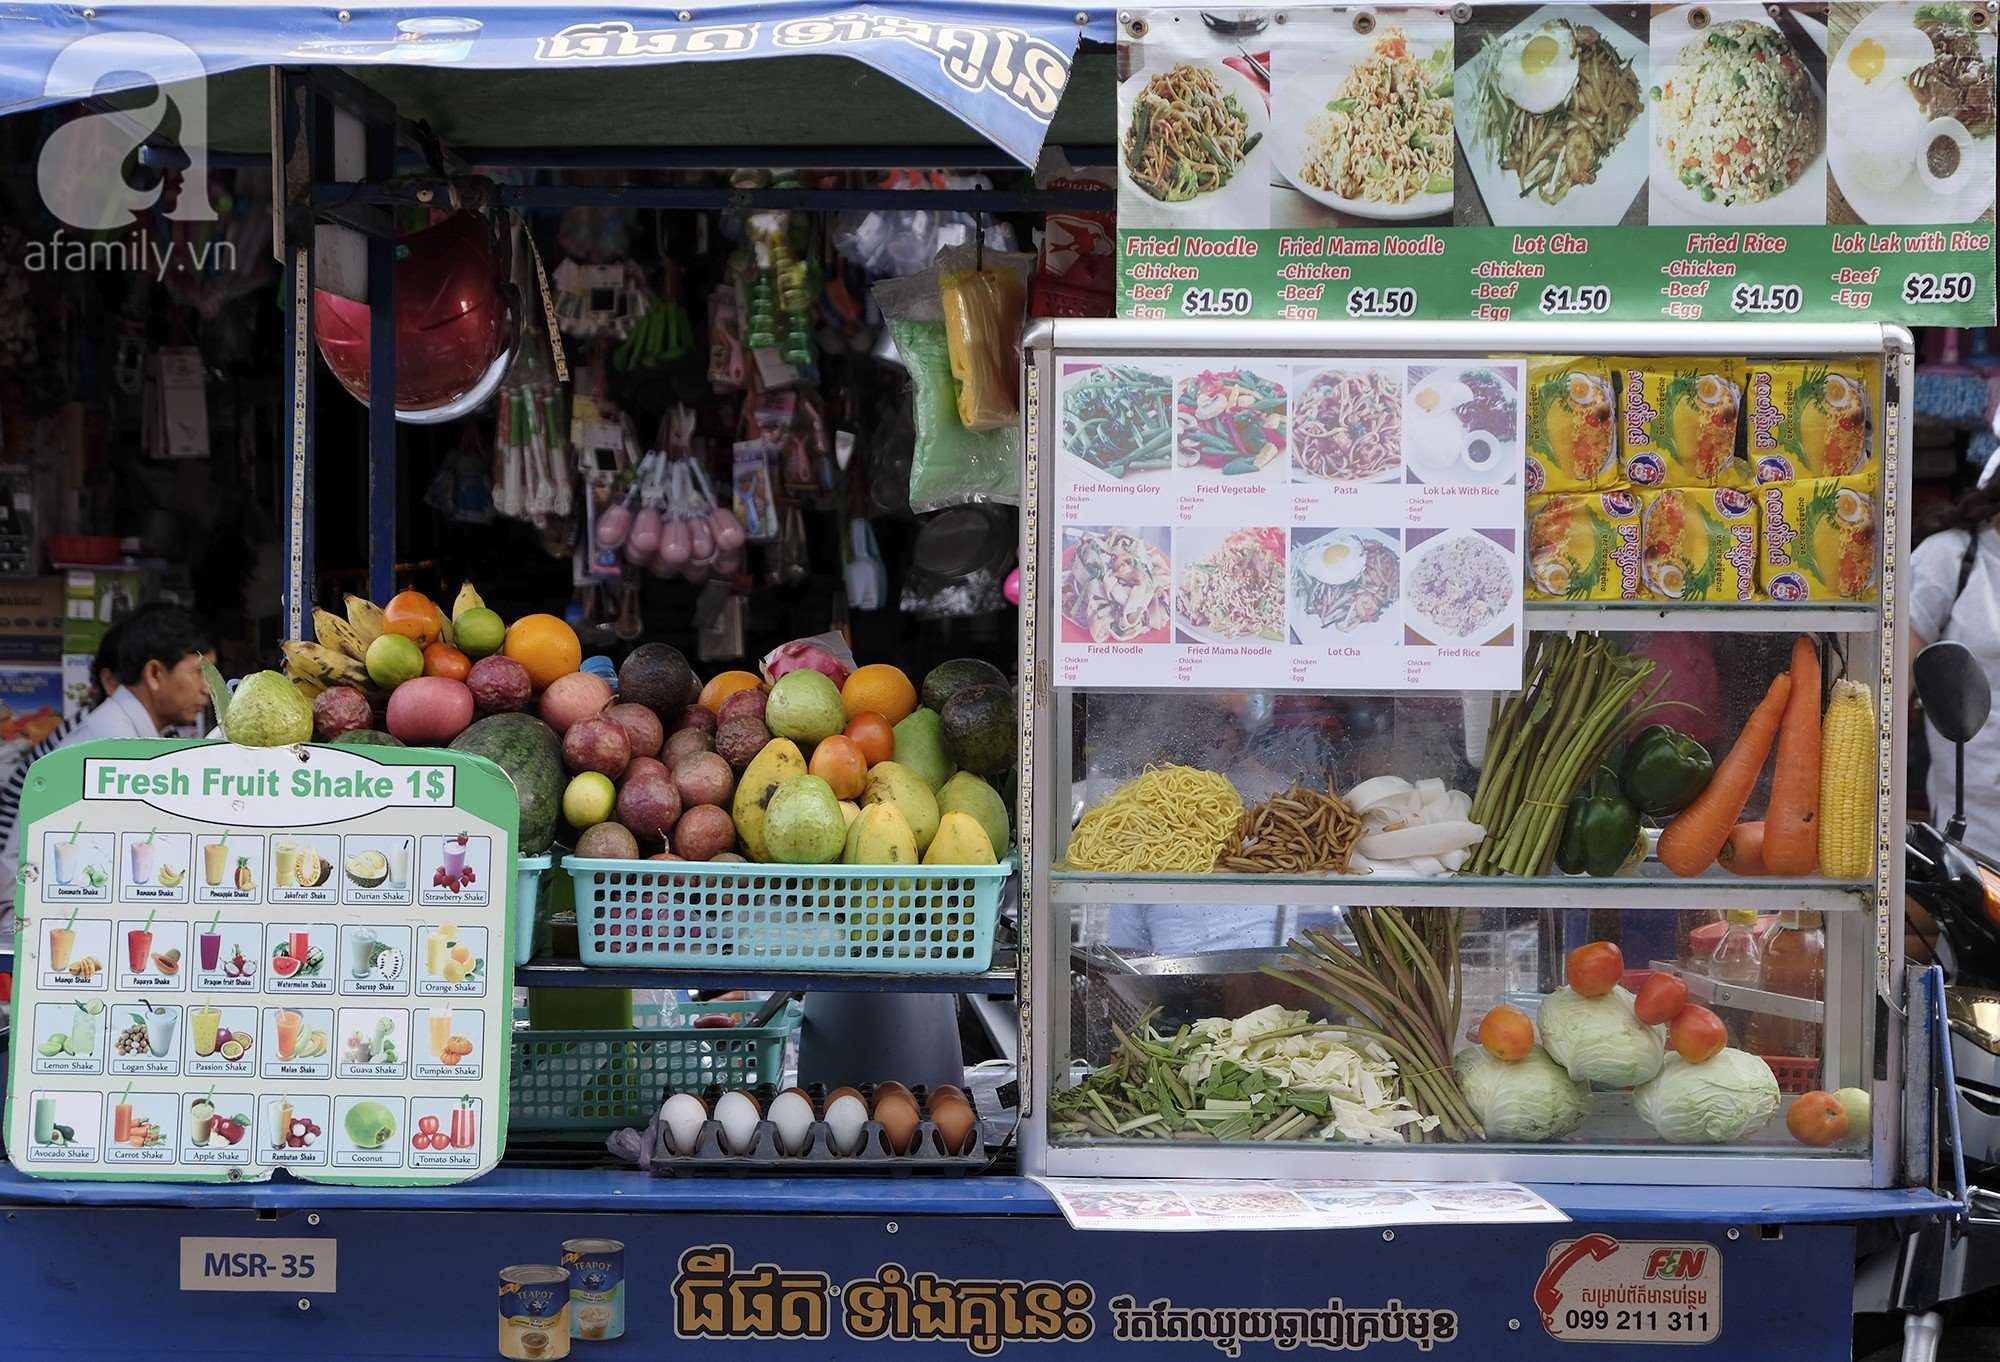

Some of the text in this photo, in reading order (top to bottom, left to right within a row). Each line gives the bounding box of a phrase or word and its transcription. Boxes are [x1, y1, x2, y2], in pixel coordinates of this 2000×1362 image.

[1127, 236, 1257, 256] Fried Noodle
[1279, 235, 1444, 256] Fried Mama Noodle
[1513, 234, 1588, 254] Lot Cha
[1687, 233, 1787, 253] Fried Rice
[1832, 232, 1989, 252] Lok Lak with Rice
[1902, 273, 1975, 304] $2.50
[1182, 288, 1251, 316] $1.50
[1347, 288, 1416, 316] $1.50
[1539, 286, 1610, 314] $1.50
[1732, 285, 1802, 312] $1.50
[1073, 484, 1160, 495] Fried Morning Glory
[1197, 485, 1266, 495] Fried Vegetable
[1334, 486, 1358, 495] Pasta
[1424, 487, 1499, 495] Lok Lak With Rice
[1112, 646, 1143, 654] Noodle
[1188, 647, 1272, 655] Fried Mama Noodle
[1328, 648, 1360, 656] Lot Cha
[1462, 649, 1480, 657] Rice
[99, 767, 445, 802] Fresh Fruit Shake 1$
[425, 893, 462, 903] Strawberry
[426, 984, 453, 993] Orange
[72, 1062, 93, 1070] Shake
[122, 1063, 145, 1072] Logan
[196, 1063, 247, 1072] Passion Shake
[420, 1067, 452, 1076] Pumpkin
[115, 1151, 139, 1159] Carrot
[193, 1152, 215, 1161] Apple
[450, 1156, 471, 1164] Shake
[575, 1261, 612, 1271] TEAPOT
[518, 1291, 554, 1299] TEAPOT
[1566, 1309, 1707, 1331] 099 211 311
